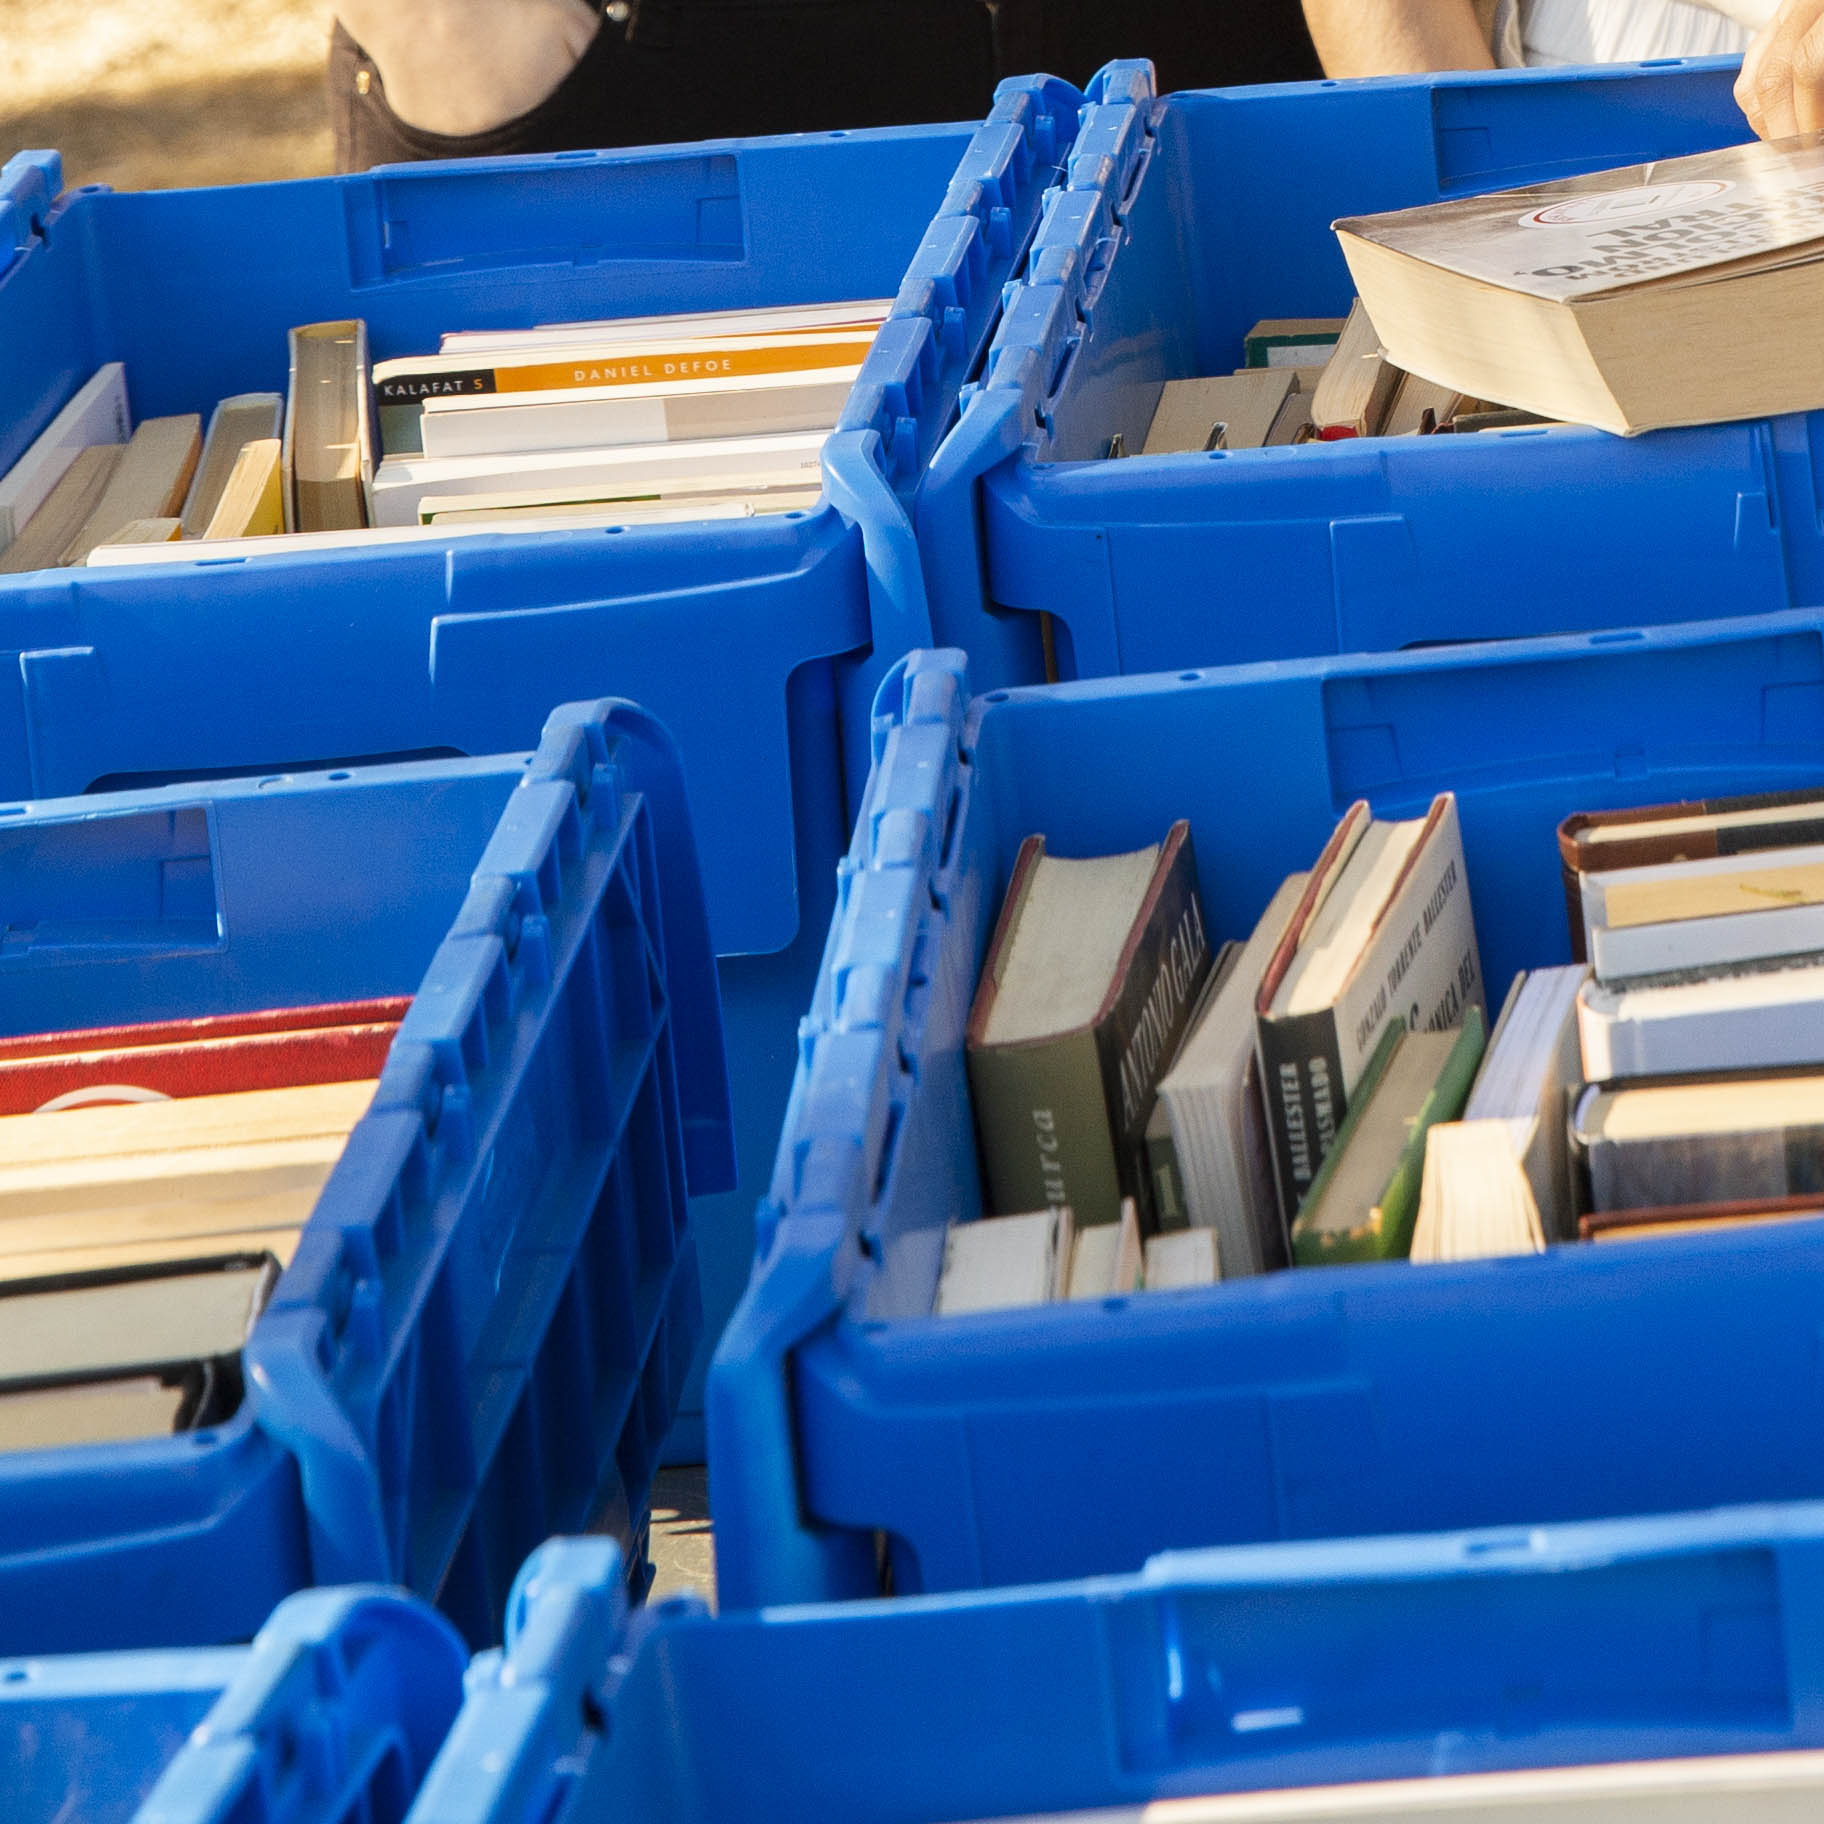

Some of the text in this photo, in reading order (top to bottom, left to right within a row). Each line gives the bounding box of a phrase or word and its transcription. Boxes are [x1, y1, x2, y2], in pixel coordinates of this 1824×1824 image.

[383, 379, 464, 397] KALAFAT
[574, 358, 734, 382] DANIEL DEFOE
[1387, 921, 1423, 998] TORRENTE
[1422, 859, 1458, 936] BALLESTER
[1120, 892, 1206, 1132] ANTONIO GALA
[1279, 1062, 1312, 1182] BALLESTER
